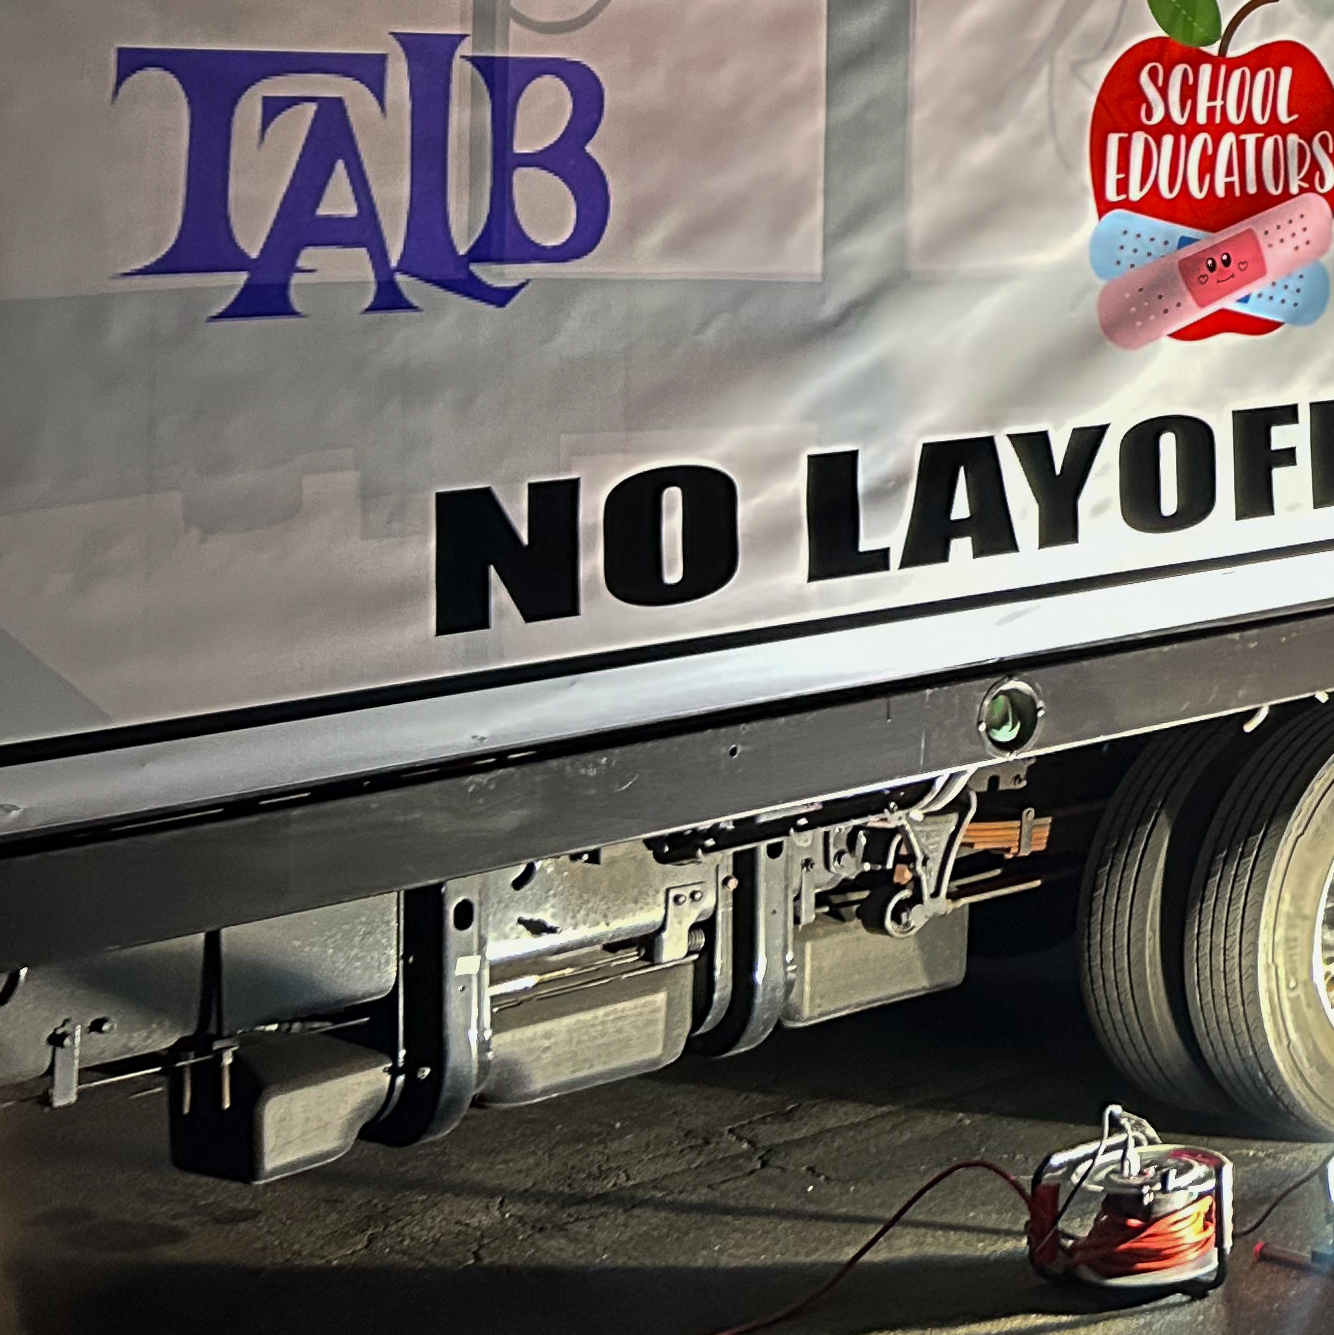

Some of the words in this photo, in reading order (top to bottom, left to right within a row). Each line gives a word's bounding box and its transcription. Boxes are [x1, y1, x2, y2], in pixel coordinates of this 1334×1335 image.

[111, 32, 611, 322] TALB
[1139, 62, 1299, 125] SCHOOL
[435, 465, 741, 637] NO
